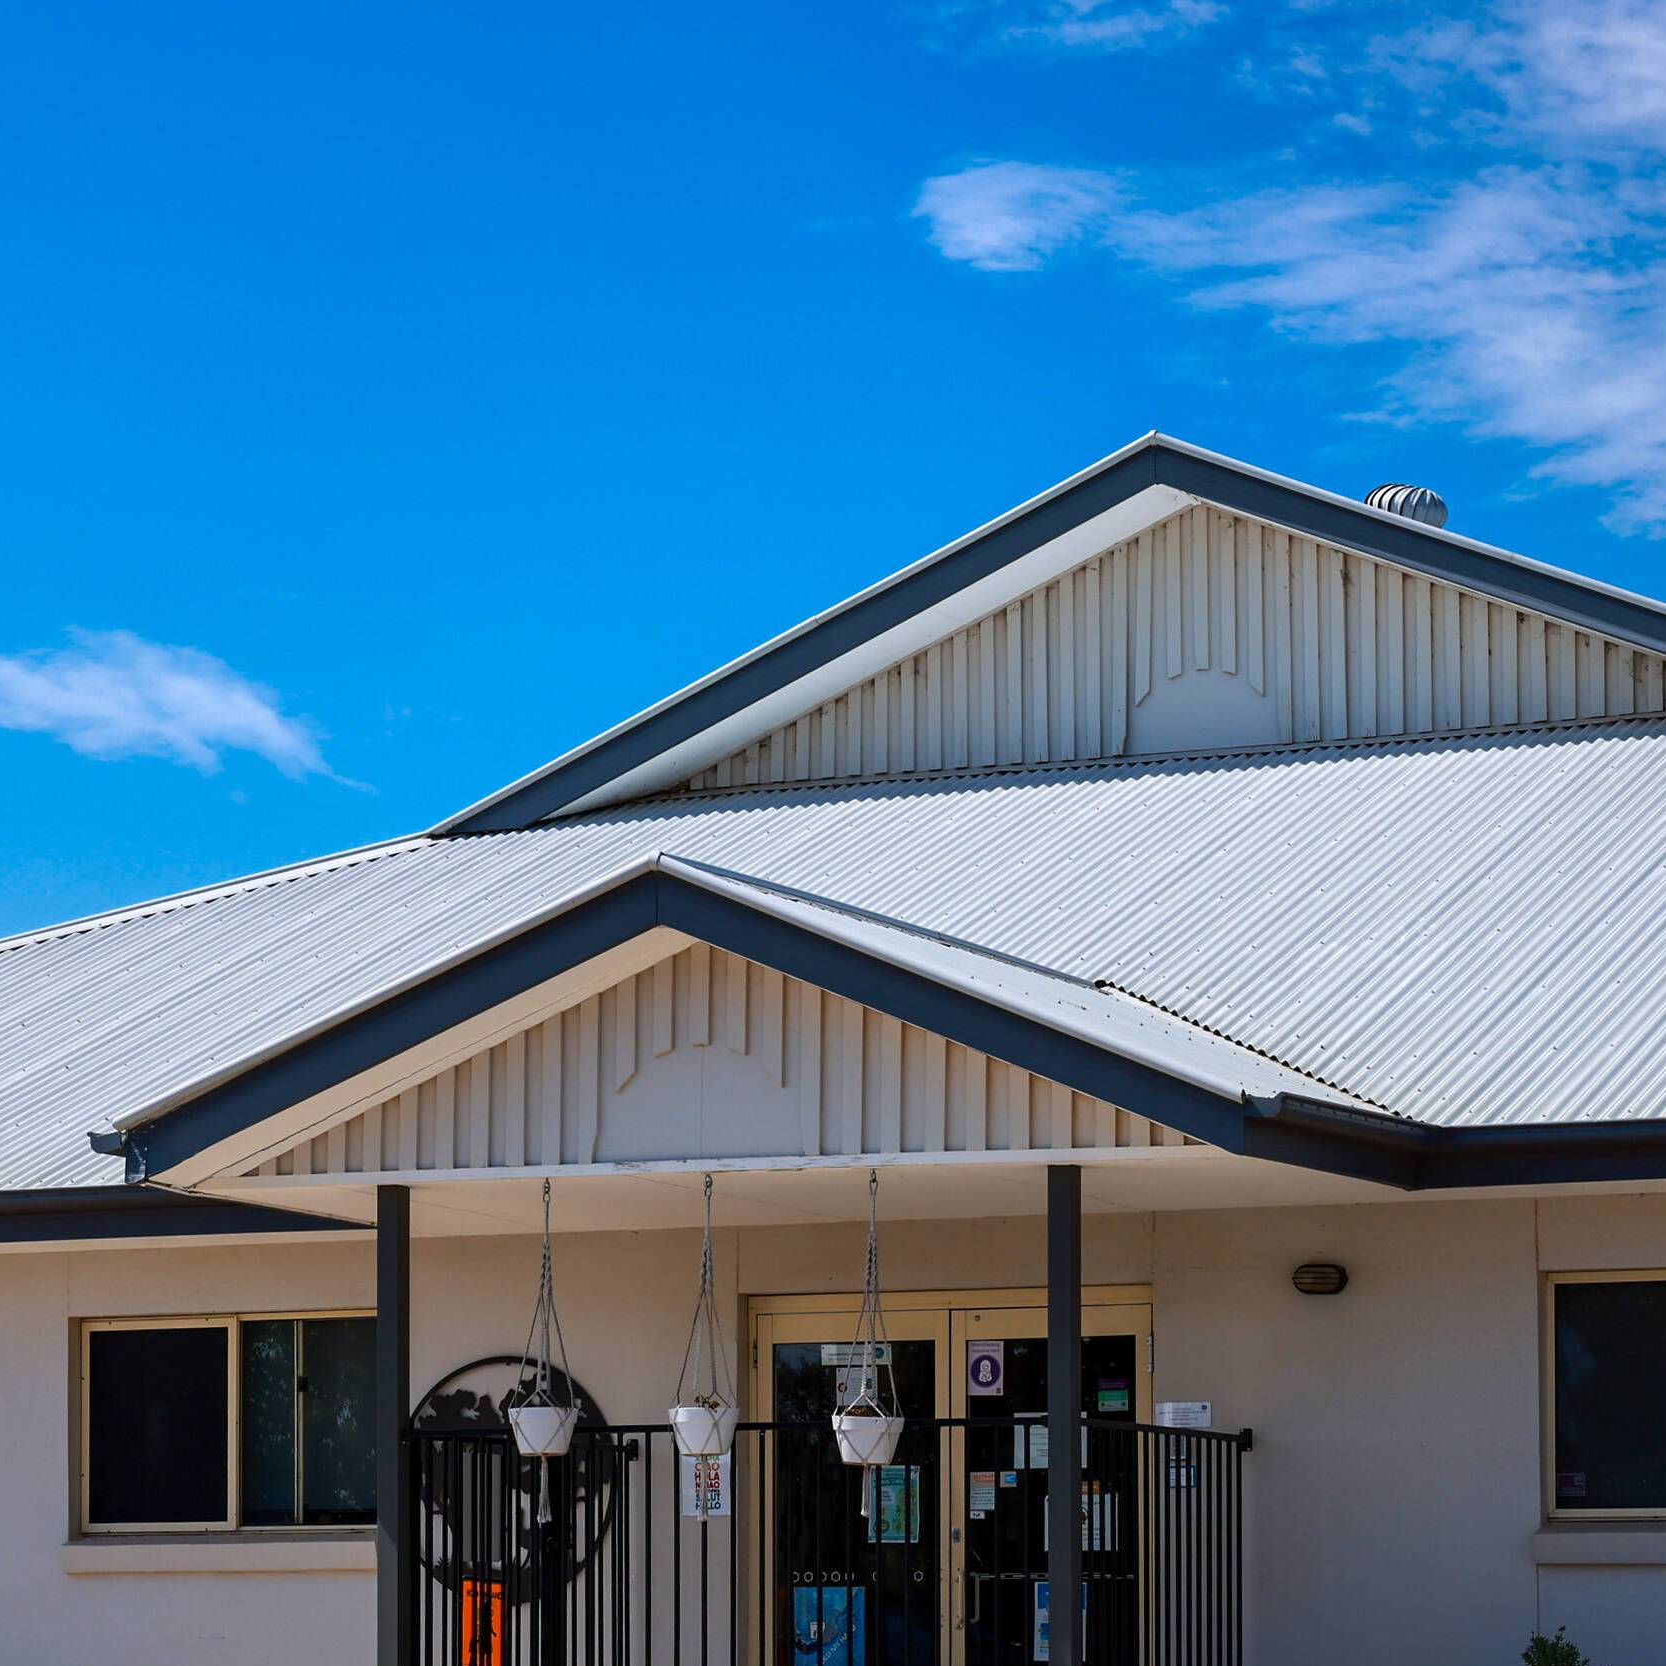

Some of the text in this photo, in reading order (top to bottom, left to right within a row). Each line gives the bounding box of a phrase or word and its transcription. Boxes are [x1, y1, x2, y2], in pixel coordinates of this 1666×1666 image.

[695, 1462, 720, 1471] CAO
[694, 1472, 720, 1481] HLA
[695, 1502, 721, 1510] HLLO
